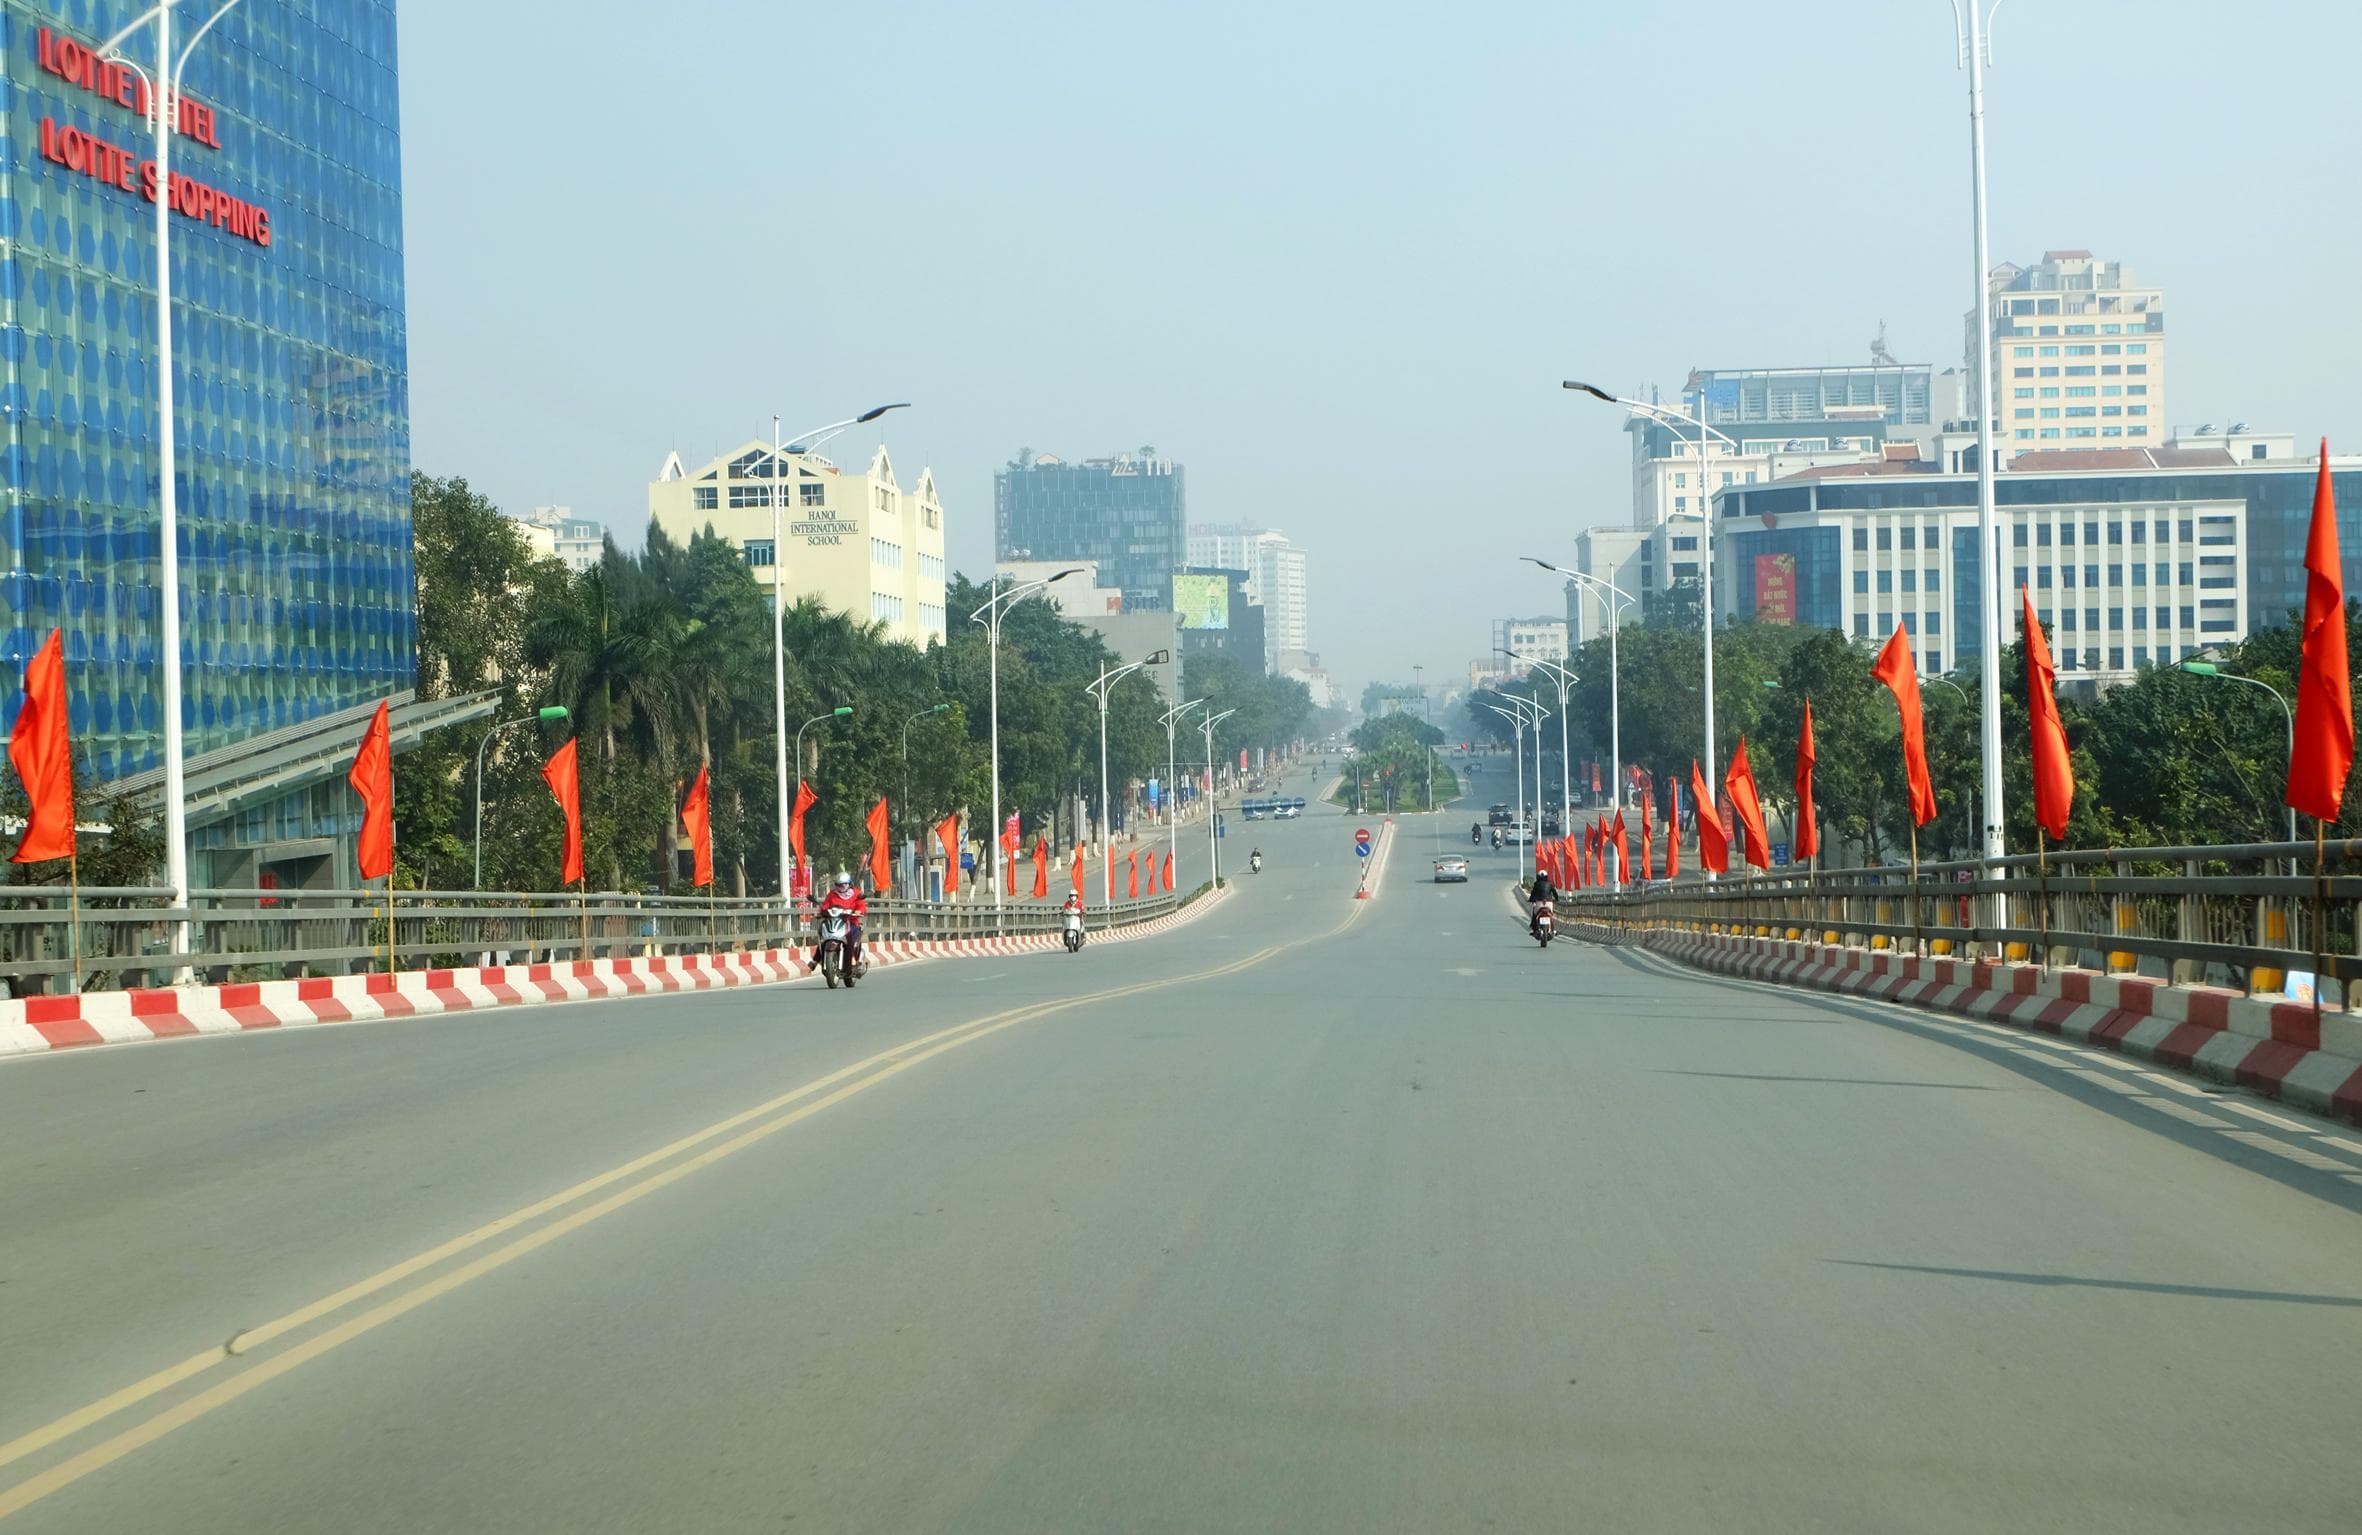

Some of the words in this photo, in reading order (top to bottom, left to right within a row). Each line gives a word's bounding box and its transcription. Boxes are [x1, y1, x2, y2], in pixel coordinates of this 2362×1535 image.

[38, 27, 133, 109] LOTTE
[40, 116, 136, 194] LOTTE
[140, 160, 271, 247] SHOPPING
[808, 510, 836, 520] HANOI
[791, 522, 859, 534] INTERNATIONAL
[807, 535, 842, 546] SCHOOL
